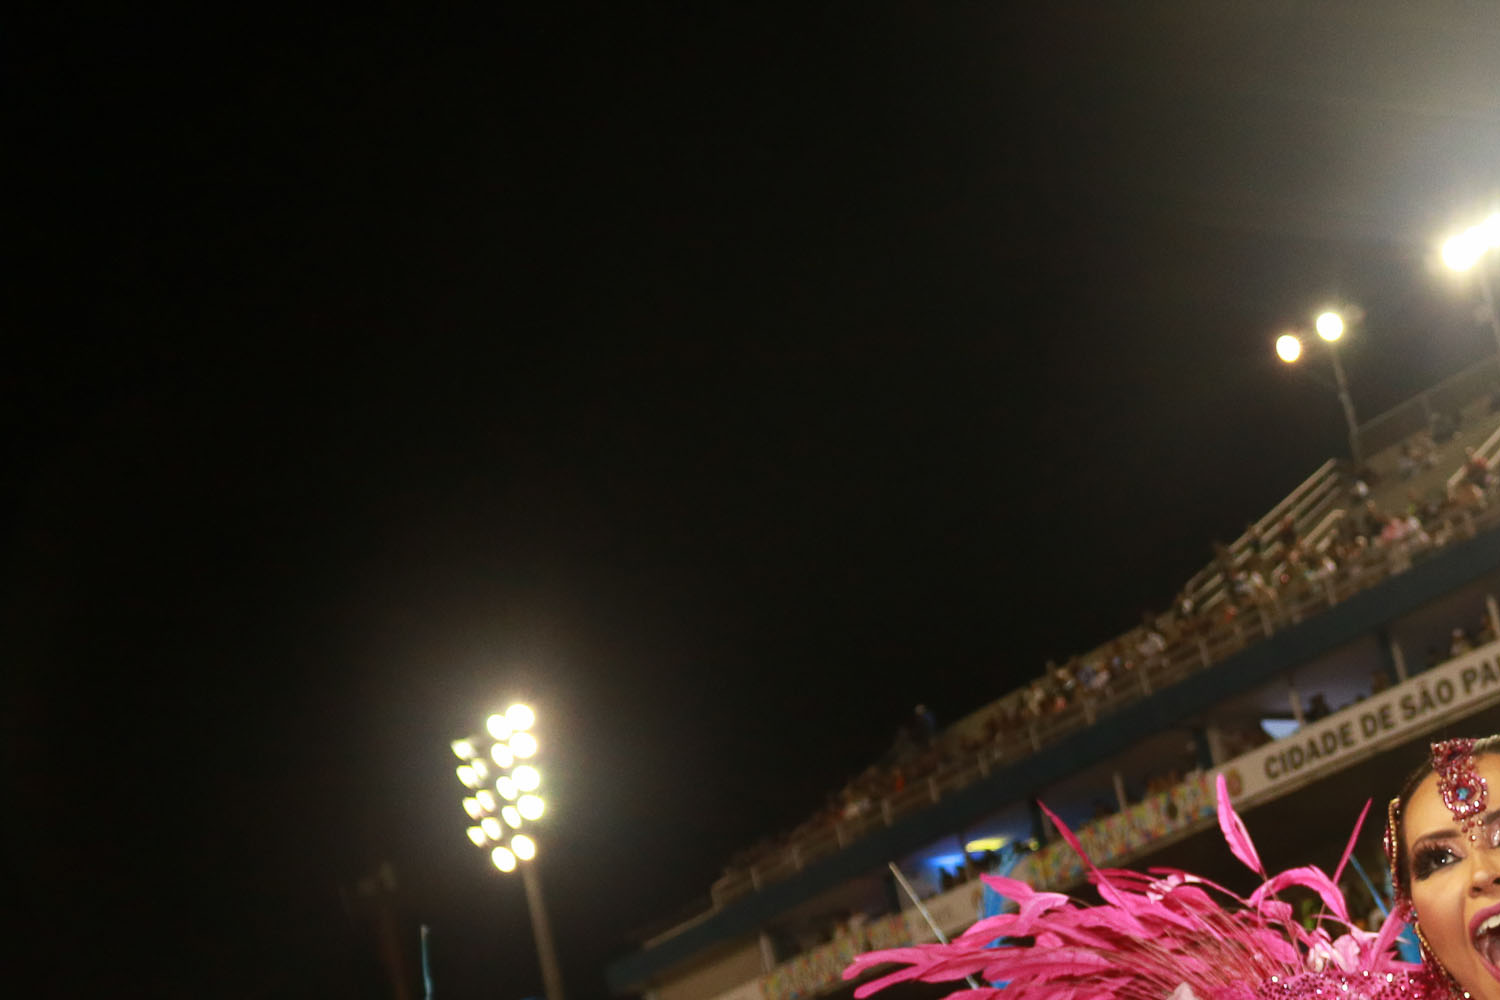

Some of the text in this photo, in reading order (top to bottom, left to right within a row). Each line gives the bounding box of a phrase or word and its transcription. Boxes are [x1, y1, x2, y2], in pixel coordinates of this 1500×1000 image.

[1263, 722, 1354, 780] CIDADE
[1361, 706, 1396, 737] DE
[1401, 678, 1456, 721] SÃO
